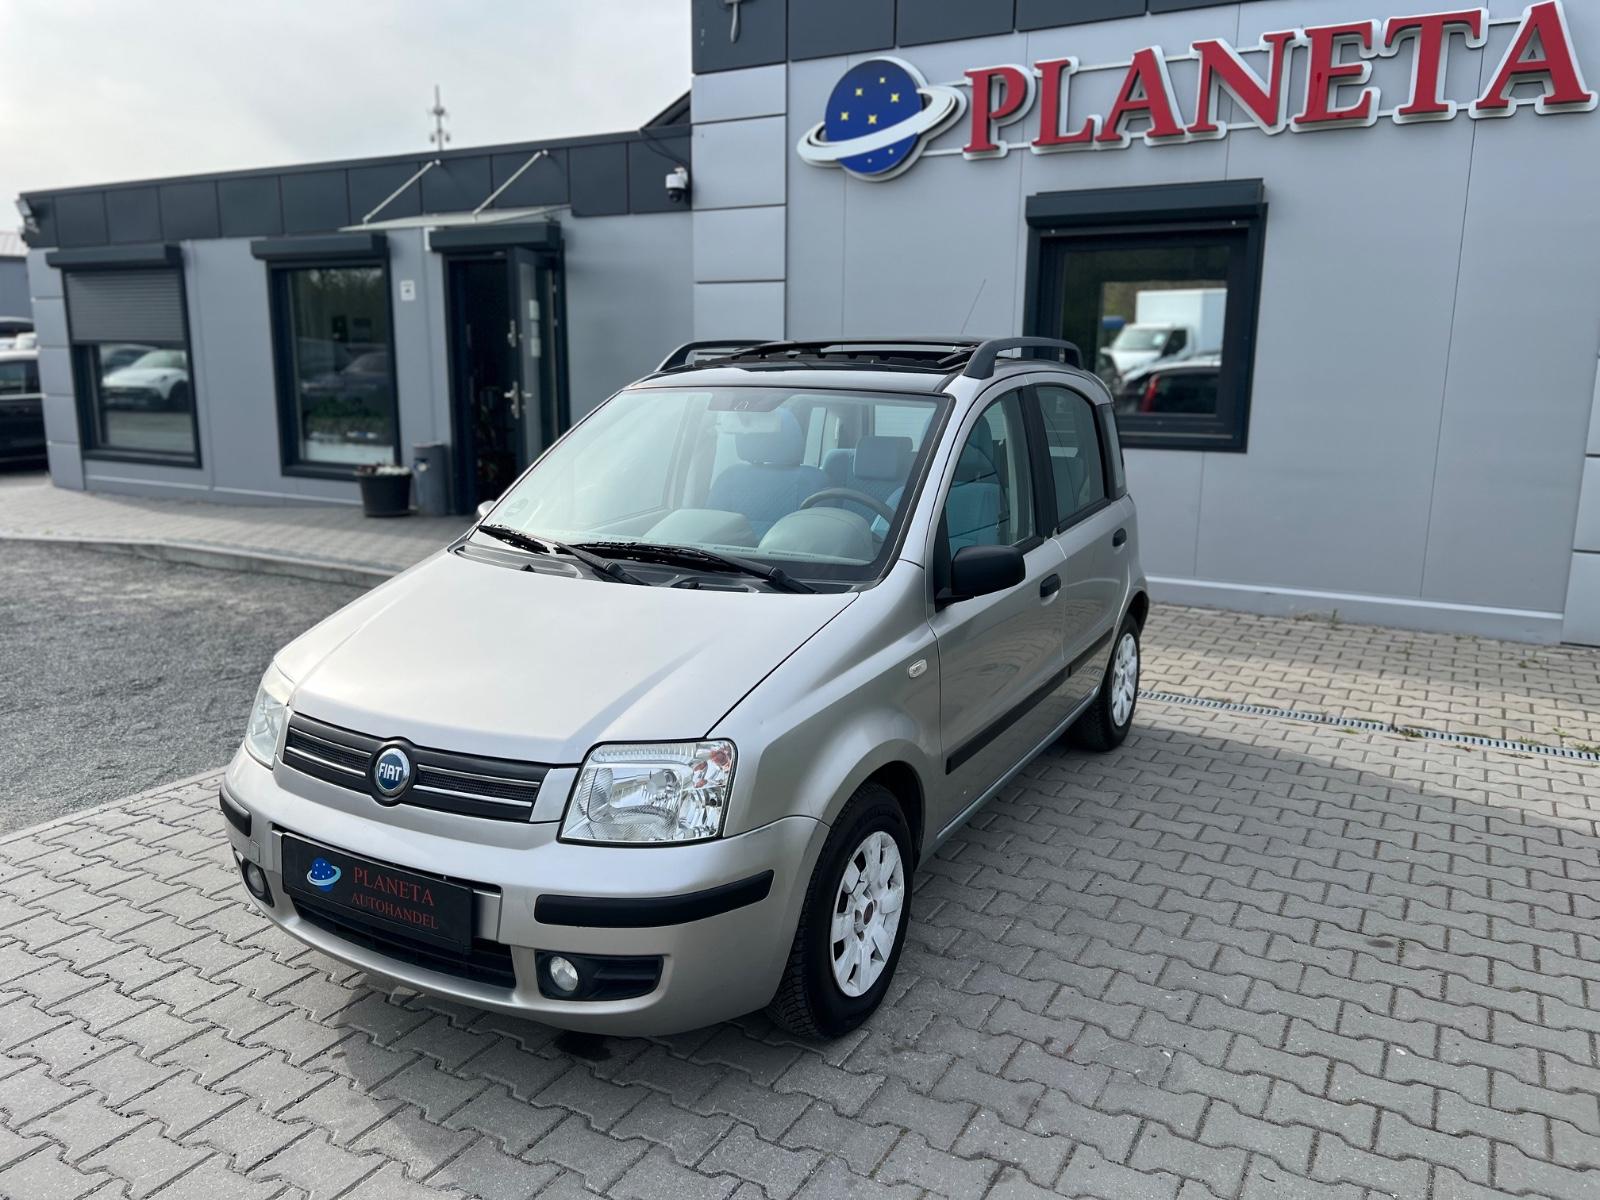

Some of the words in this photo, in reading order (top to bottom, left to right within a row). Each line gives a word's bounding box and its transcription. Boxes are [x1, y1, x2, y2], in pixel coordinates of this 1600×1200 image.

[963, 0, 1594, 157] PLANETA
[378, 762, 402, 782] FIAT
[353, 867, 435, 906] PLANETA
[351, 893, 438, 929] AUTOHANDEL
